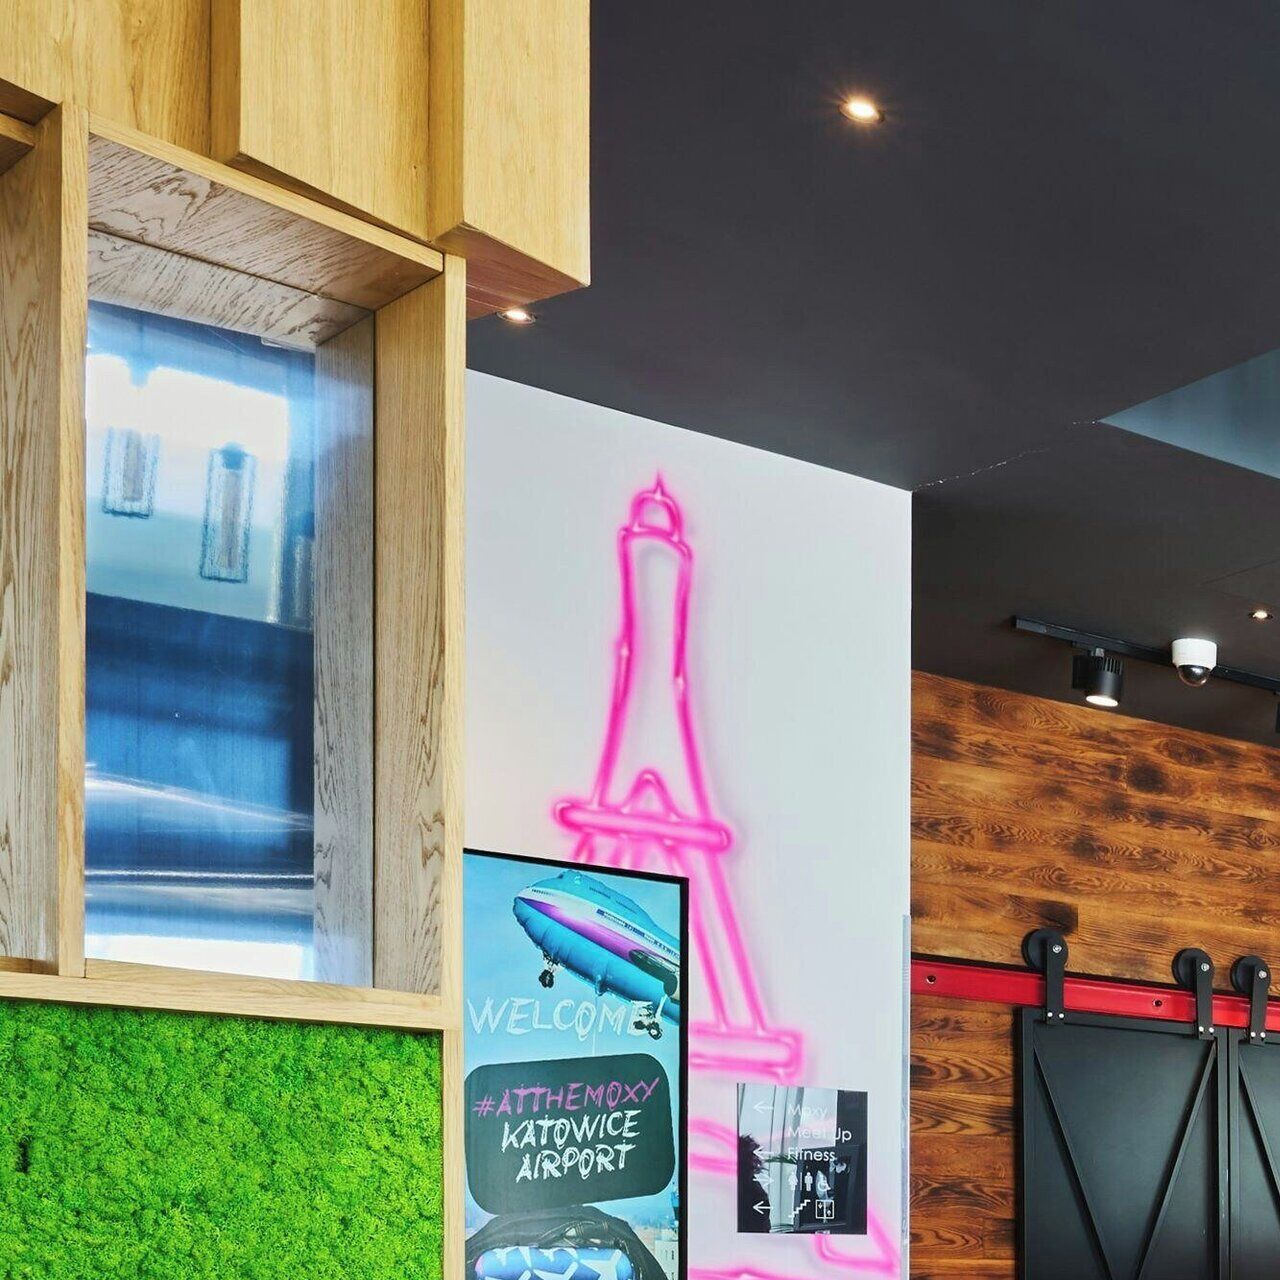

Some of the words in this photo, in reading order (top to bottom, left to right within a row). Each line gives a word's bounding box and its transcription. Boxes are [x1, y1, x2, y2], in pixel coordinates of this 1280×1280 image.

[472, 1077, 660, 1120] #ATTHEMOXY
[788, 1103, 828, 1119] Moxy
[501, 1109, 642, 1152] KATOWICE
[516, 1139, 637, 1183] AIRPORT
[788, 1147, 836, 1162] Fitness
